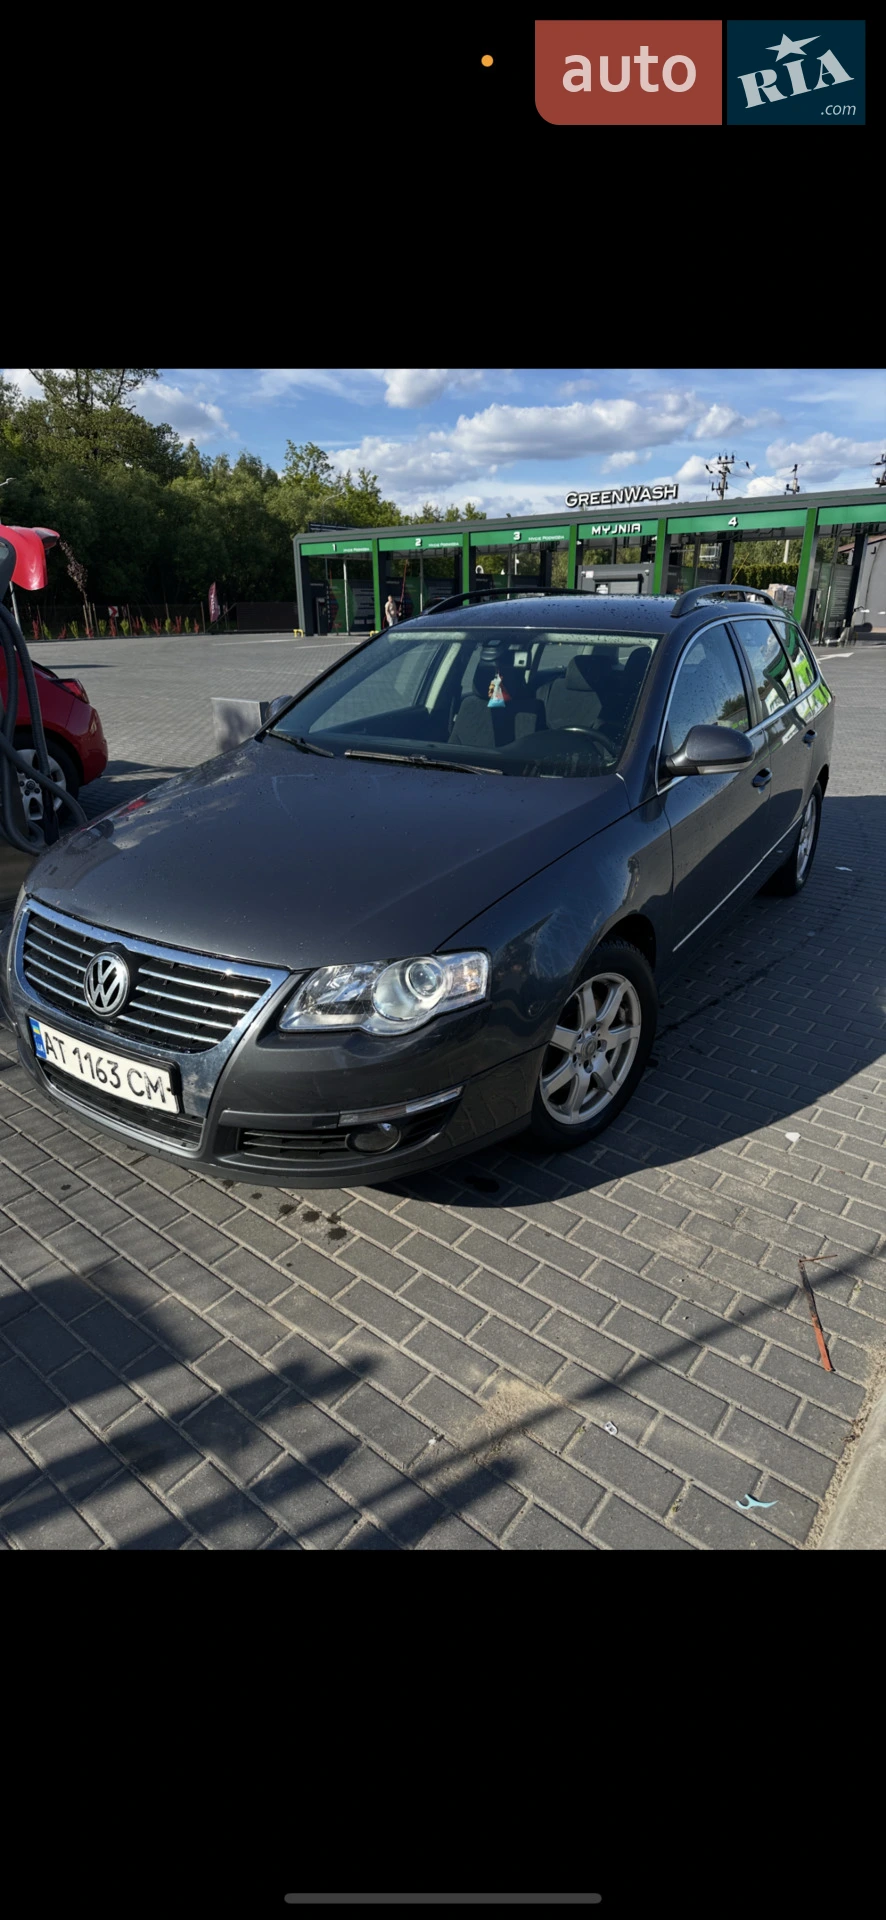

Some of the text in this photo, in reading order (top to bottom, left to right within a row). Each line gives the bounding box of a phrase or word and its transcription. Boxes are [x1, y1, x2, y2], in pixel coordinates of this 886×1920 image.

[727, 516, 739, 528] 4
[591, 523, 642, 536] MYJNIA
[513, 531, 521, 541] 3
[332, 543, 337, 552] 1
[415, 538, 422, 547] 2
[44, 1031, 167, 1104] AT 1163 CM
